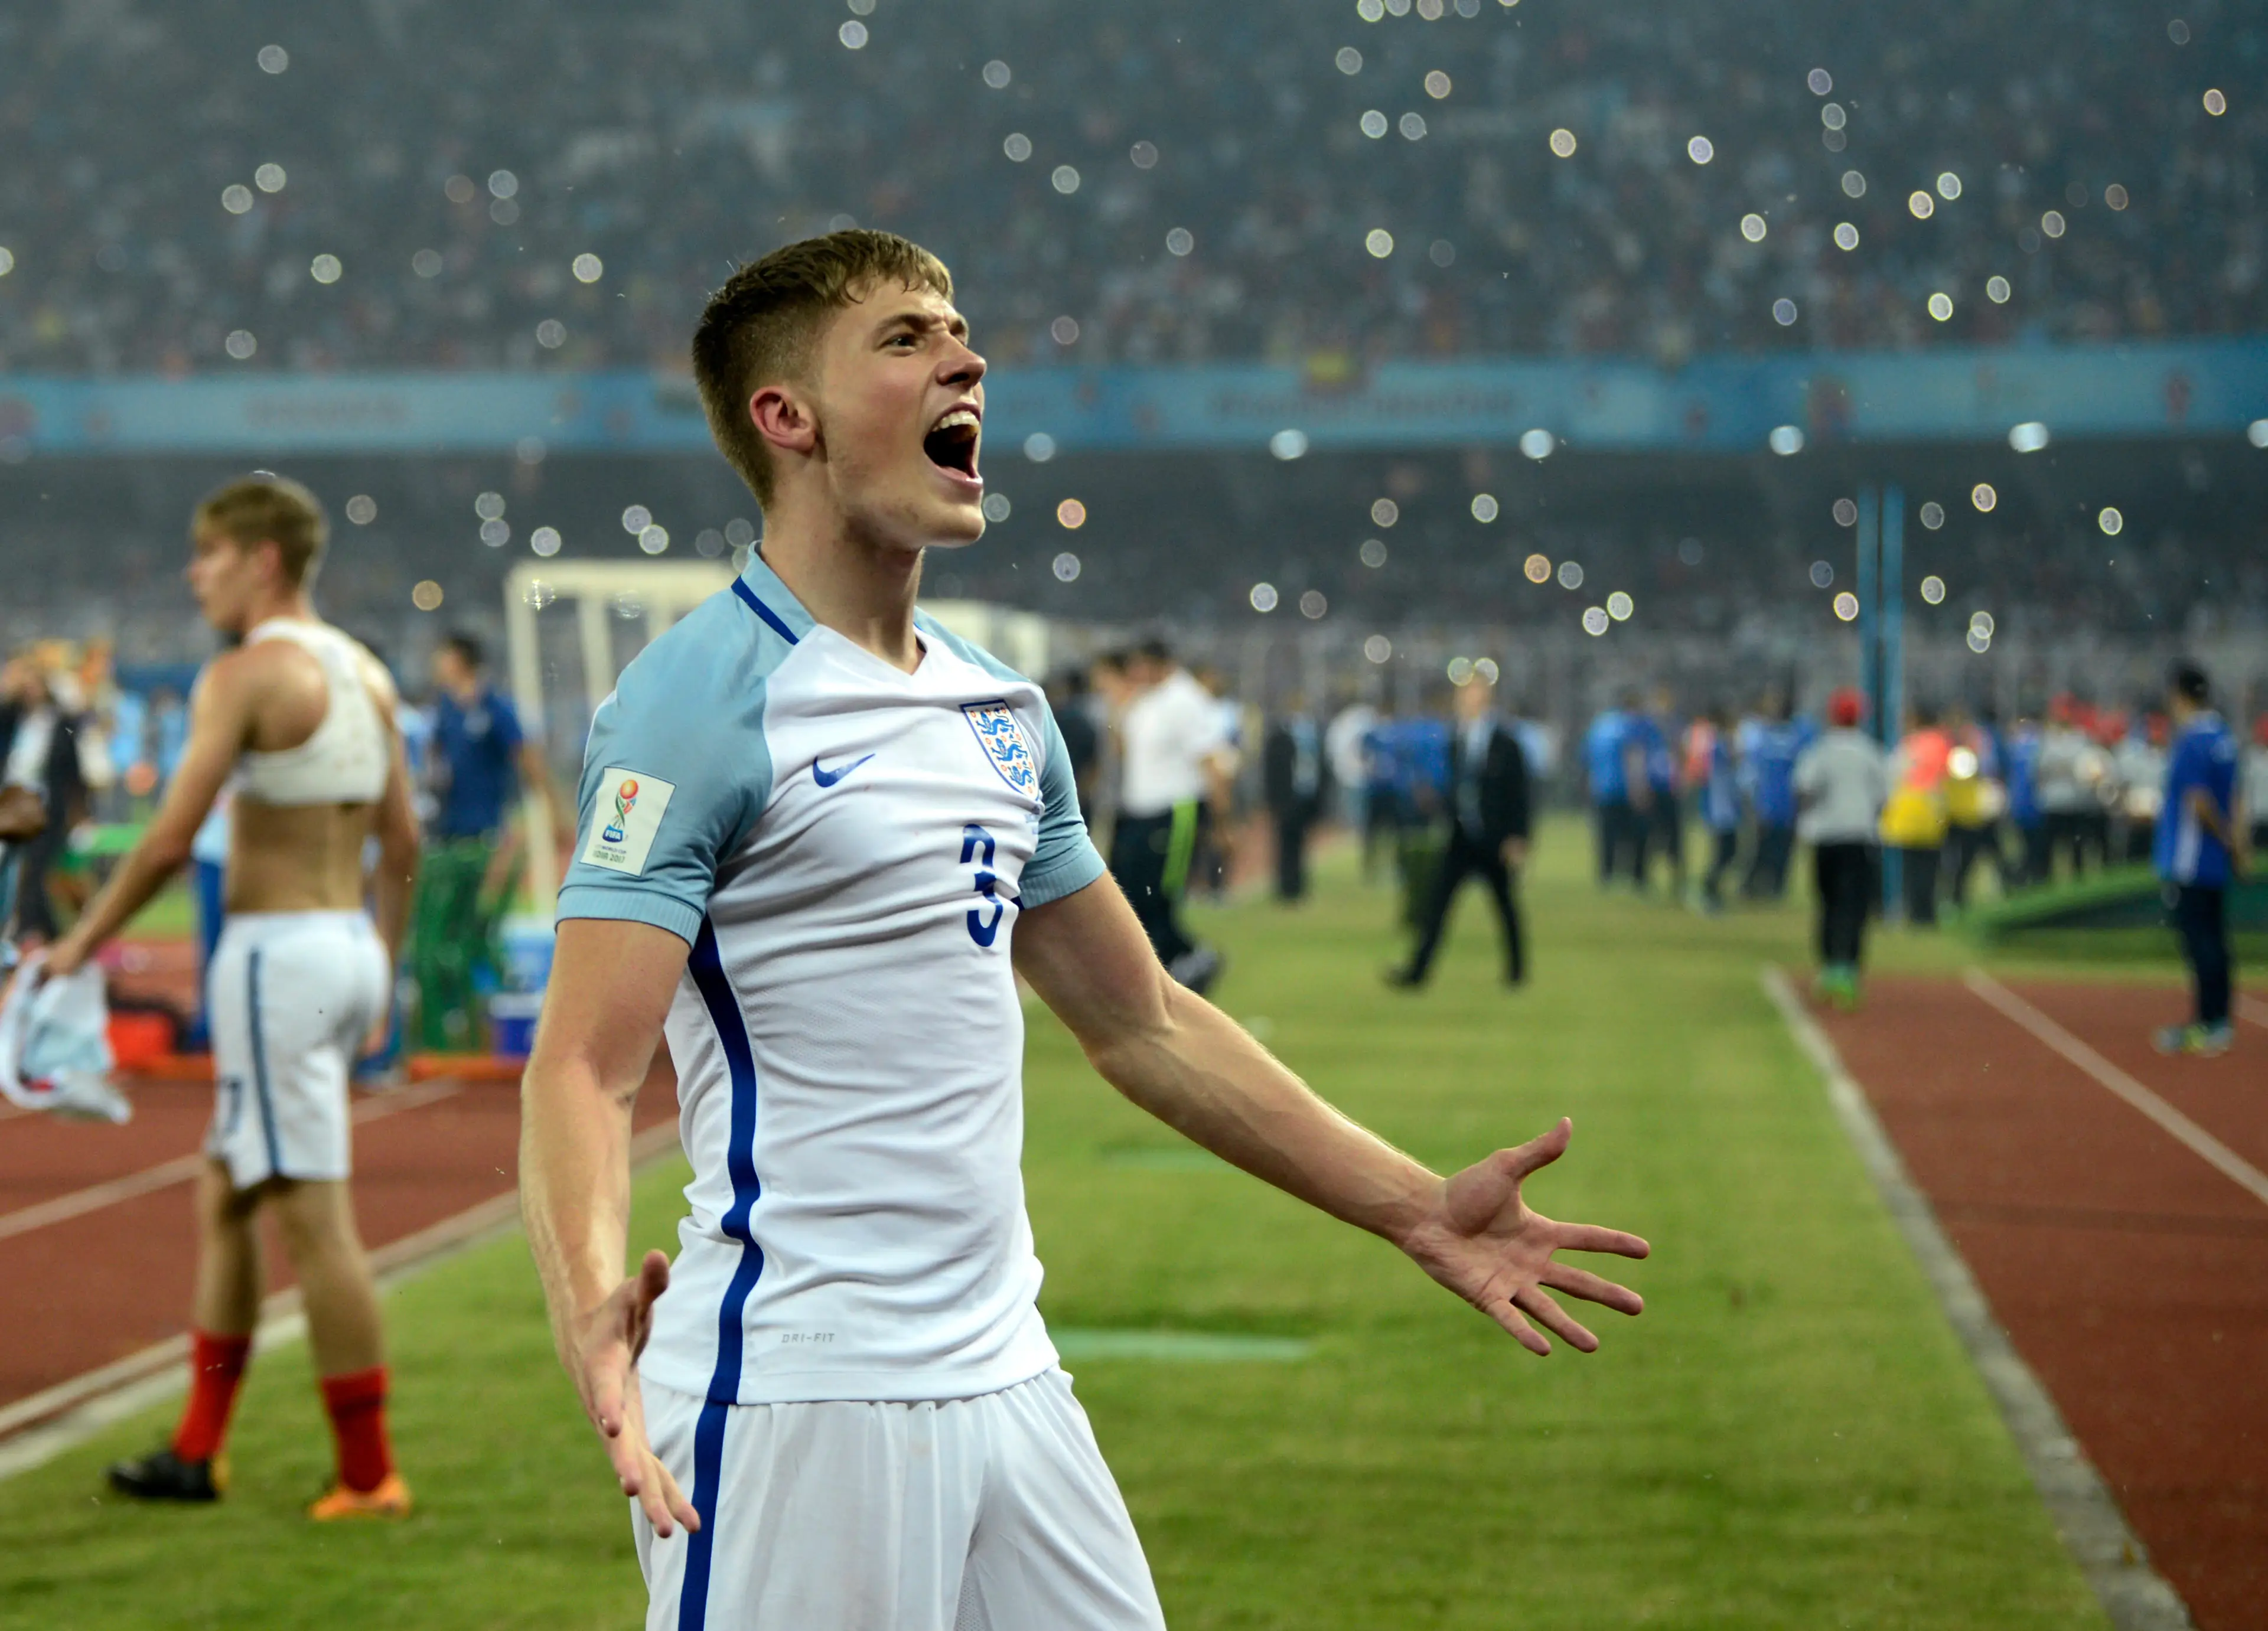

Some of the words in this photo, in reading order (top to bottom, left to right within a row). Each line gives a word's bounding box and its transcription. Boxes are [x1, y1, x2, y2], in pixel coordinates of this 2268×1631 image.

[609, 853, 625, 863] 2017
[960, 823, 1003, 947] 3
[781, 1333, 835, 1343] DRI-FIT
